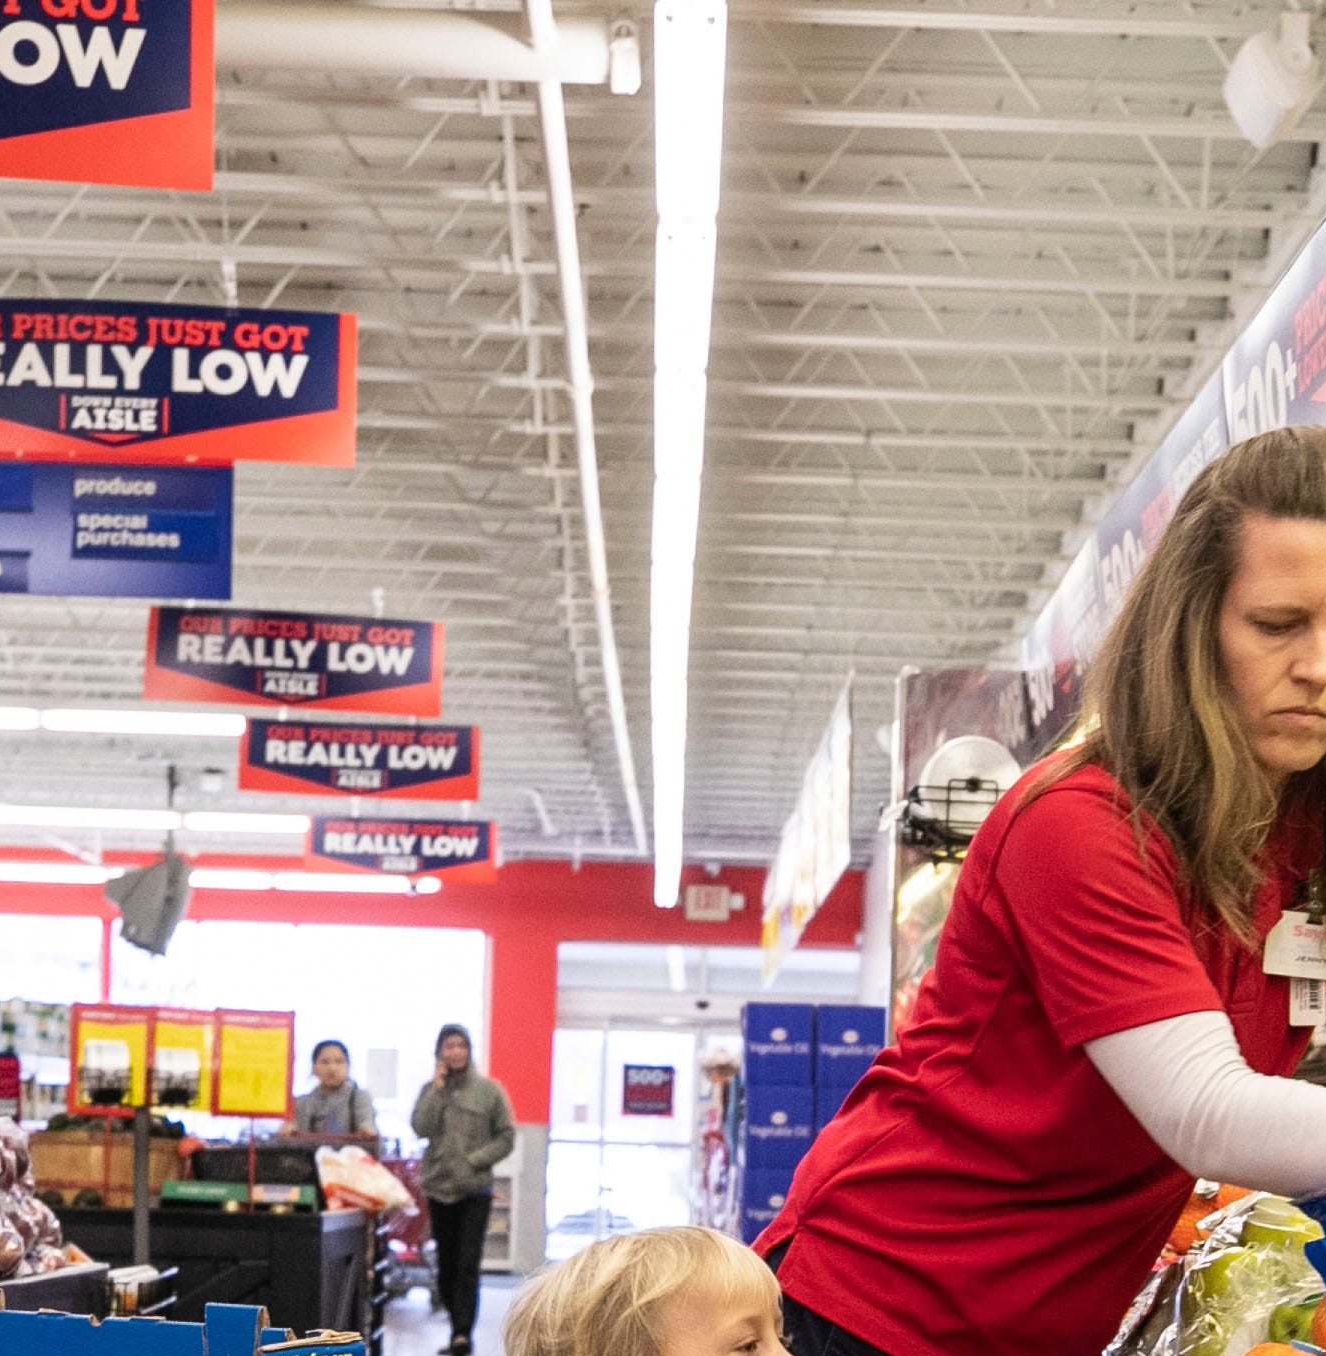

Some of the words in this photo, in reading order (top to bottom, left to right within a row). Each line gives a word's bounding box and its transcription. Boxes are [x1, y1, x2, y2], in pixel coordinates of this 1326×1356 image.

[11, 314, 139, 344] PRICES
[146, 320, 226, 351] JUST
[233, 322, 311, 353] GOT
[171, 348, 311, 399] LOW
[71, 408, 159, 433] AISLE
[74, 474, 158, 499] produce
[77, 510, 150, 533] special
[76, 528, 181, 551] purchases
[366, 626, 416, 646] GOT
[177, 633, 319, 670] REALLY
[326, 643, 416, 676] LOW
[263, 676, 320, 697] AISLE
[265, 739, 386, 771] REALLY
[387, 745, 458, 772] LOW
[324, 832, 417, 856] REALLY
[421, 835, 480, 858] LOW
